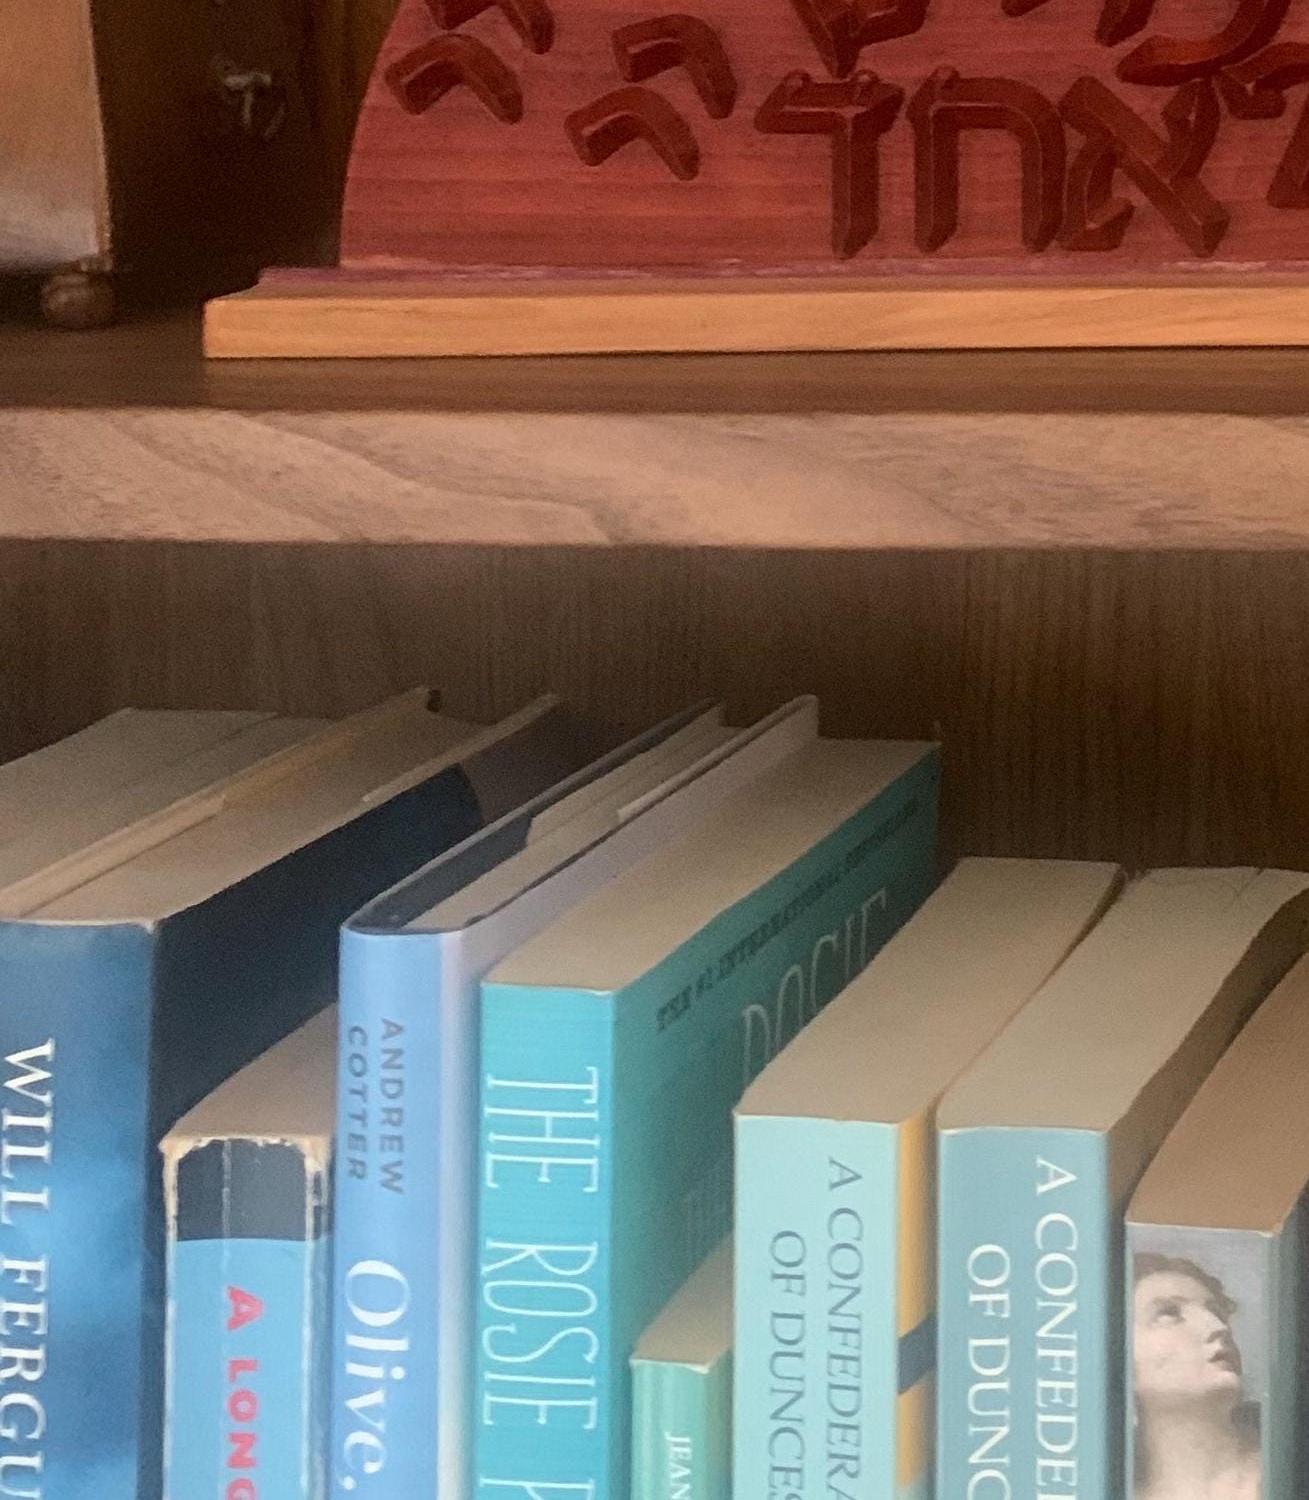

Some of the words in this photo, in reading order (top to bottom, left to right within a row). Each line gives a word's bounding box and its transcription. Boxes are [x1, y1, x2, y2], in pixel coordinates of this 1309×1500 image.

[2, 1037, 56, 1226] WILL
[348, 1025, 368, 1180] COTTER
[381, 1017, 405, 1194] ANDREW
[484, 1066, 600, 1192] THE
[829, 1156, 863, 1191] A
[1036, 1155, 1078, 1197] A
[226, 1284, 265, 1331] A
[769, 1230, 807, 1297] OF
[967, 1243, 1012, 1319] OF
[481, 1238, 599, 1430] ROSIE
[1034, 1212, 1079, 1500] CONFEDE
